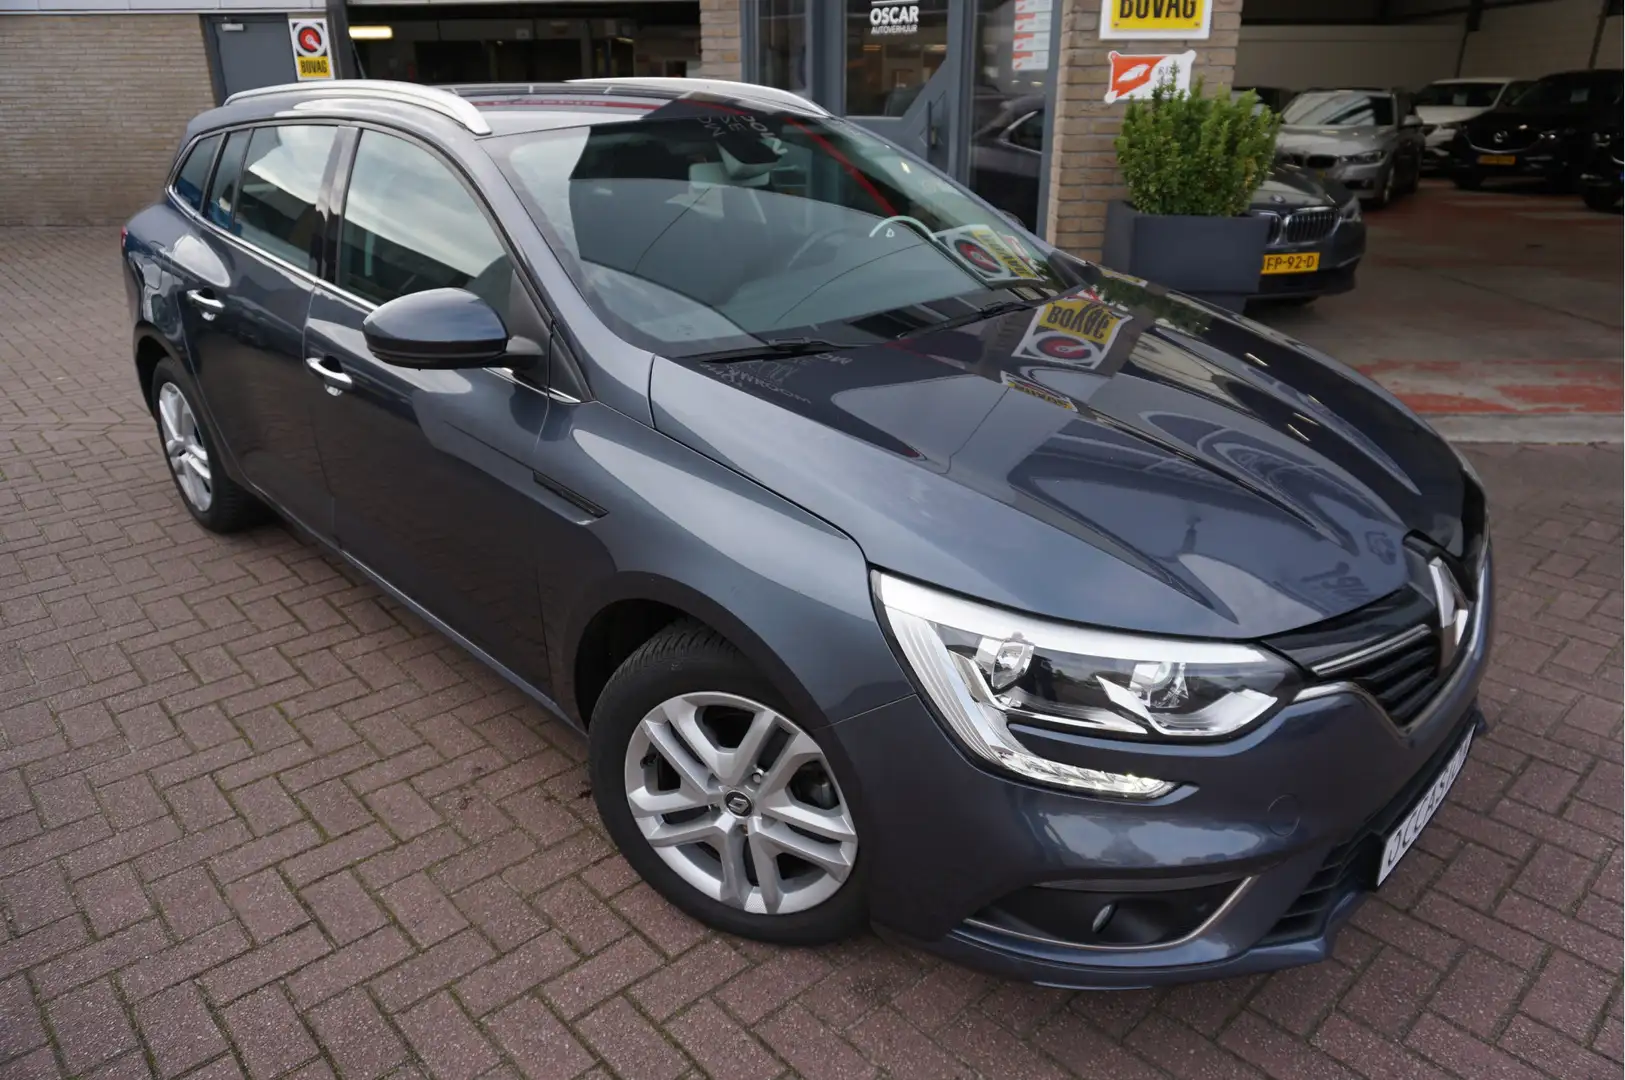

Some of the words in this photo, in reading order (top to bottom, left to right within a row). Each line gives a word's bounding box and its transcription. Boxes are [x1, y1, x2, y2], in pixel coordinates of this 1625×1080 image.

[870, 5, 919, 25] OSCAR
[871, 24, 918, 35] AUTOVERHUUR
[300, 59, 328, 74] BOVAG
[1263, 255, 1315, 270] FP-92-D
